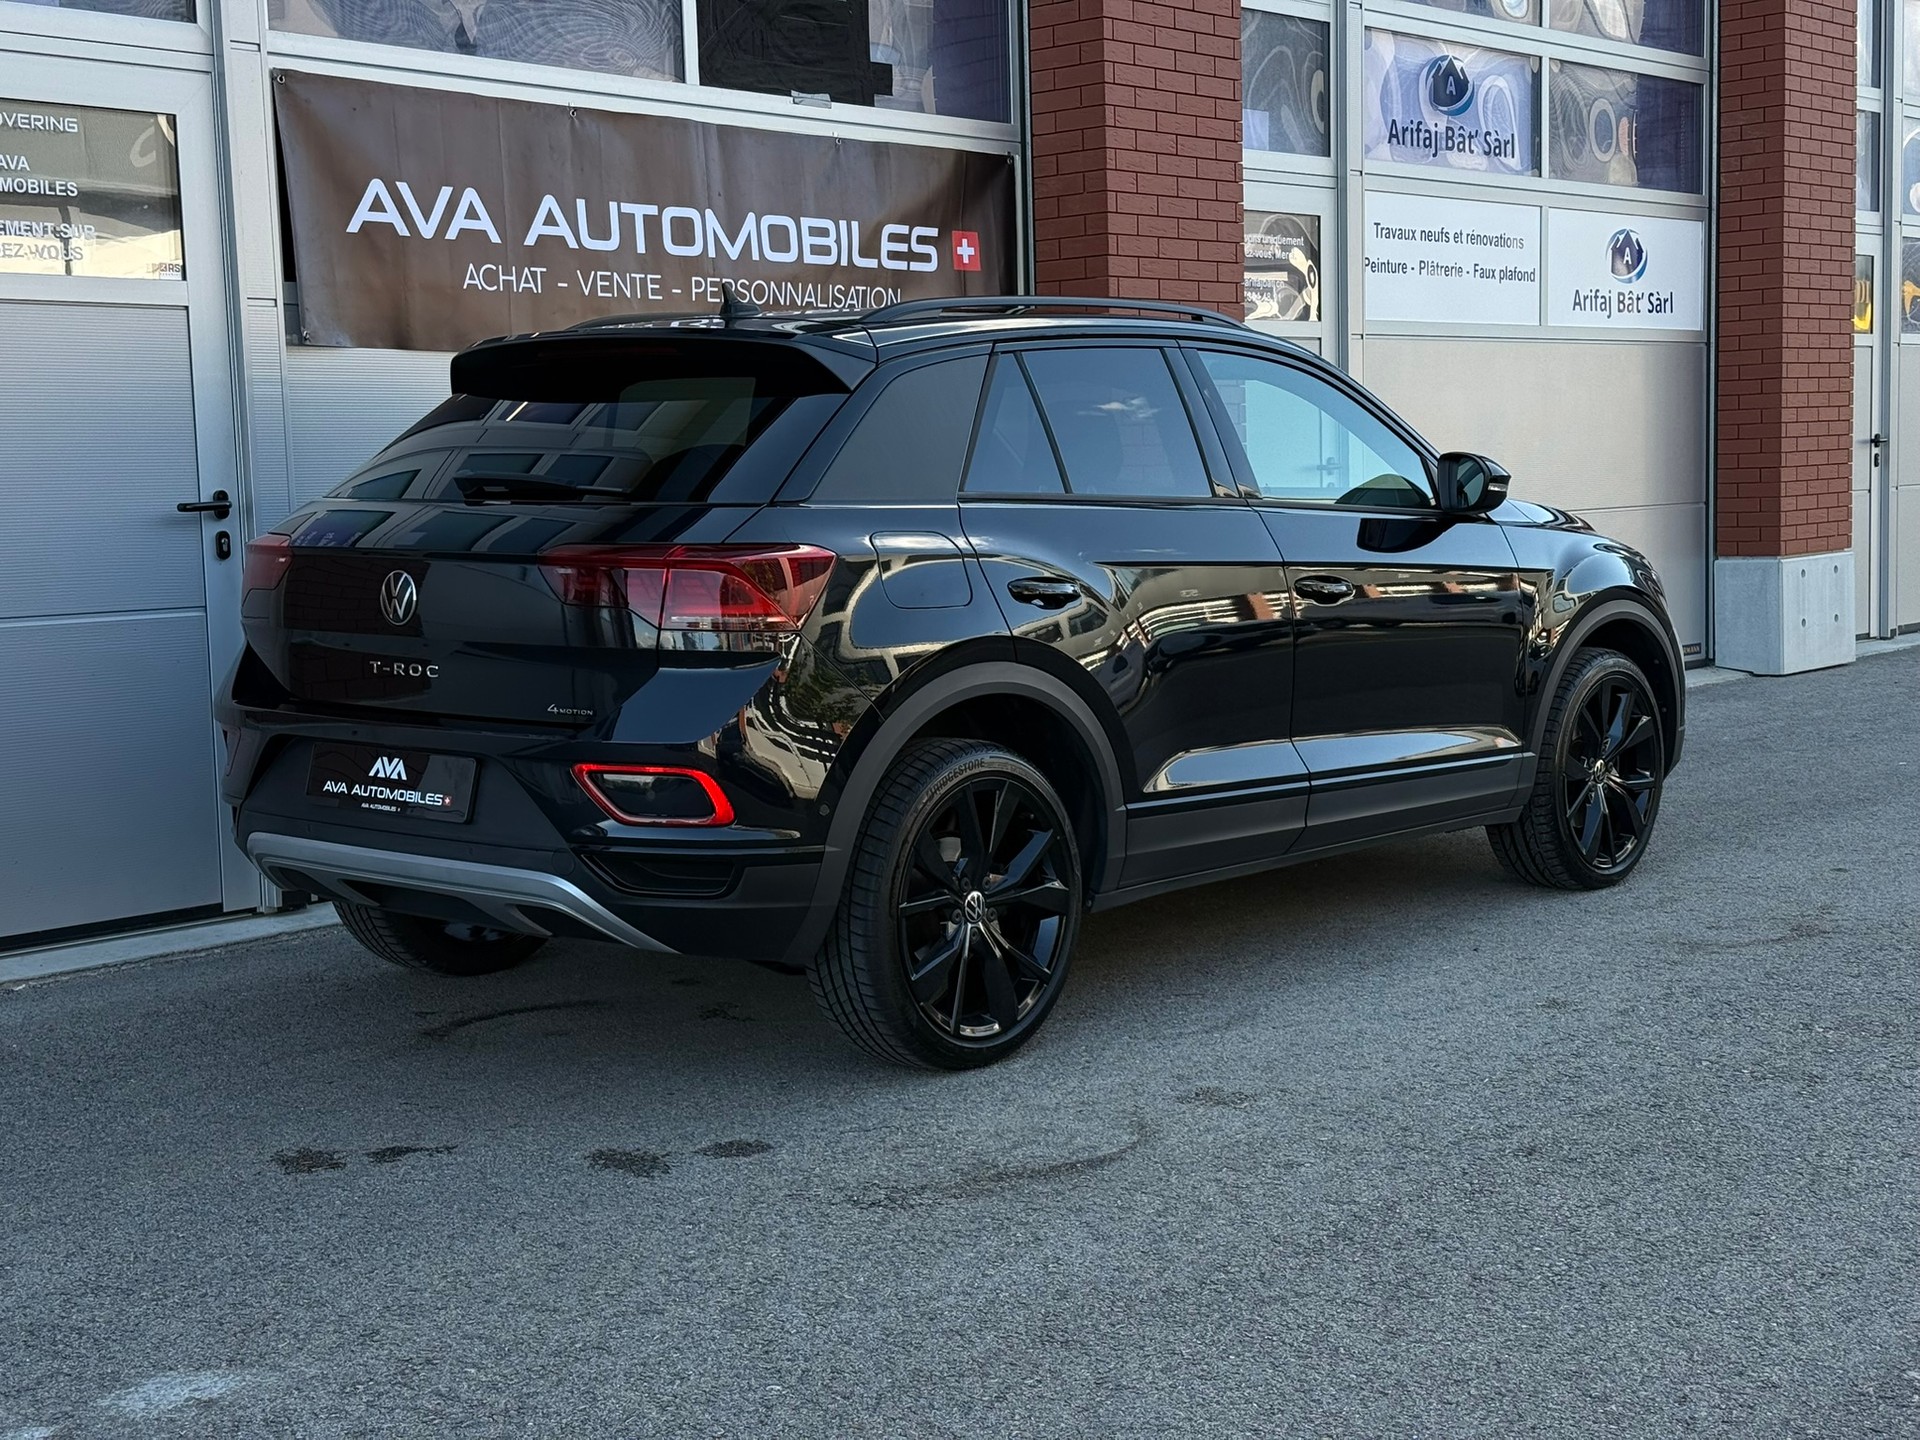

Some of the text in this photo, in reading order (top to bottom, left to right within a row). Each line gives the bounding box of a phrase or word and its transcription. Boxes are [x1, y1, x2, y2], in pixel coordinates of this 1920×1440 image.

[0, 112, 78, 132] VERING
[1387, 119, 1438, 158] Arifaj
[1483, 130, 1515, 159] Sàrl
[60, 223, 96, 240] SUR
[346, 178, 938, 271] AVA AUTOMOBILES
[1373, 222, 1525, 250] Travaux neufs et rénovations
[463, 263, 547, 293] ACHAT
[577, 269, 663, 300] VENTE
[1364, 257, 1408, 275] Peinture
[1418, 259, 1463, 278] Plâtrerie
[1473, 263, 1497, 280] Faux
[1499, 265, 1536, 284] plafond
[1572, 289, 1612, 319] Arifaj
[1647, 291, 1673, 314] Sàrl
[369, 660, 440, 679] T-ROC
[547, 703, 594, 716] 4MOTION
[322, 780, 444, 806] AVA AUTOMOBILES
